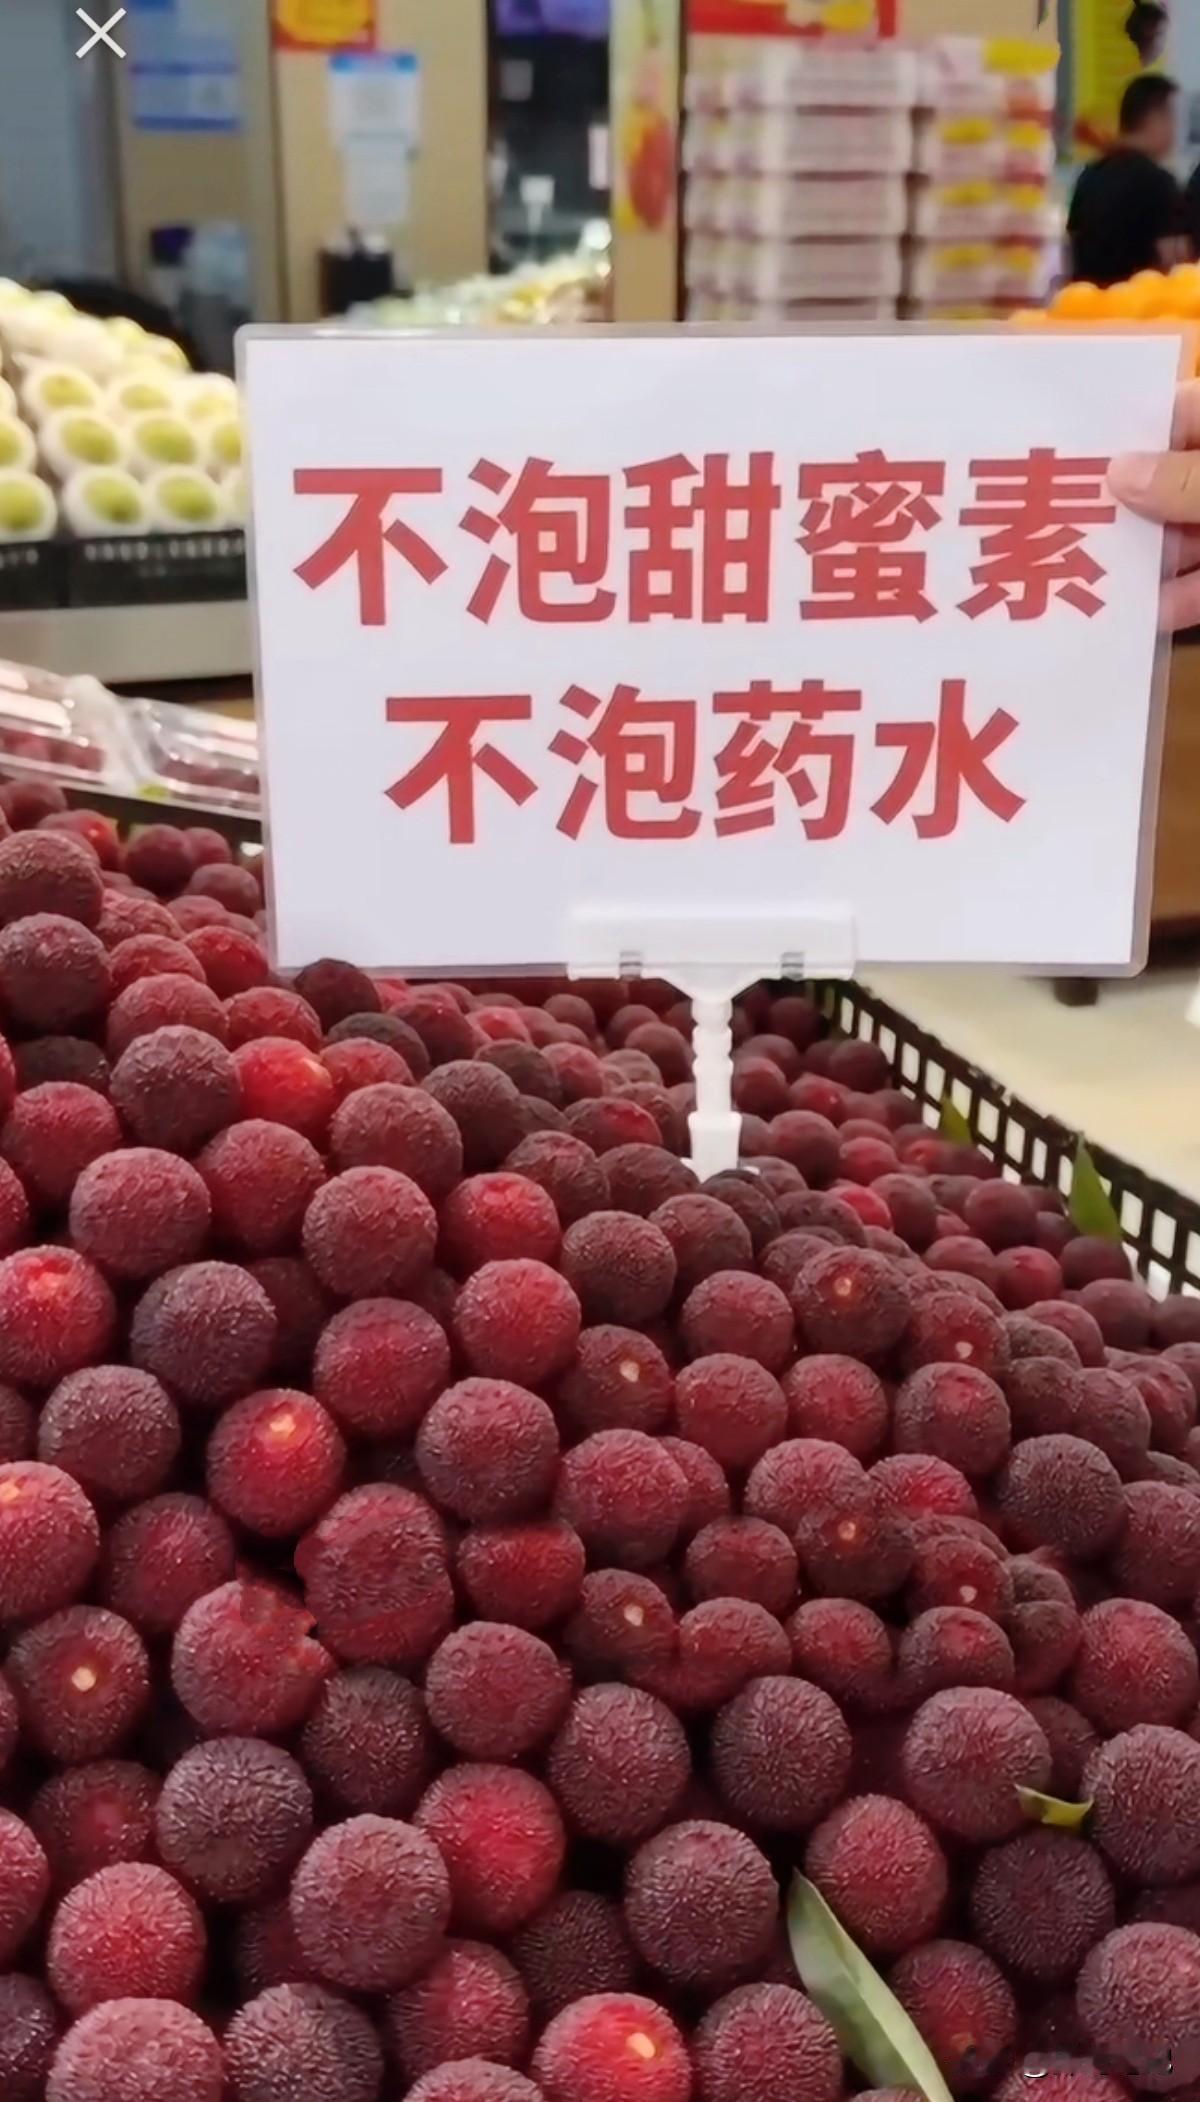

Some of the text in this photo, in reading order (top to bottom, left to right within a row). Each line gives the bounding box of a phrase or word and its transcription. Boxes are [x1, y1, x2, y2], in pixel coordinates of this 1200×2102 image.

[292, 448, 1117, 626] 不泡甜蜜素
[383, 678, 1027, 845] 不泡药水
